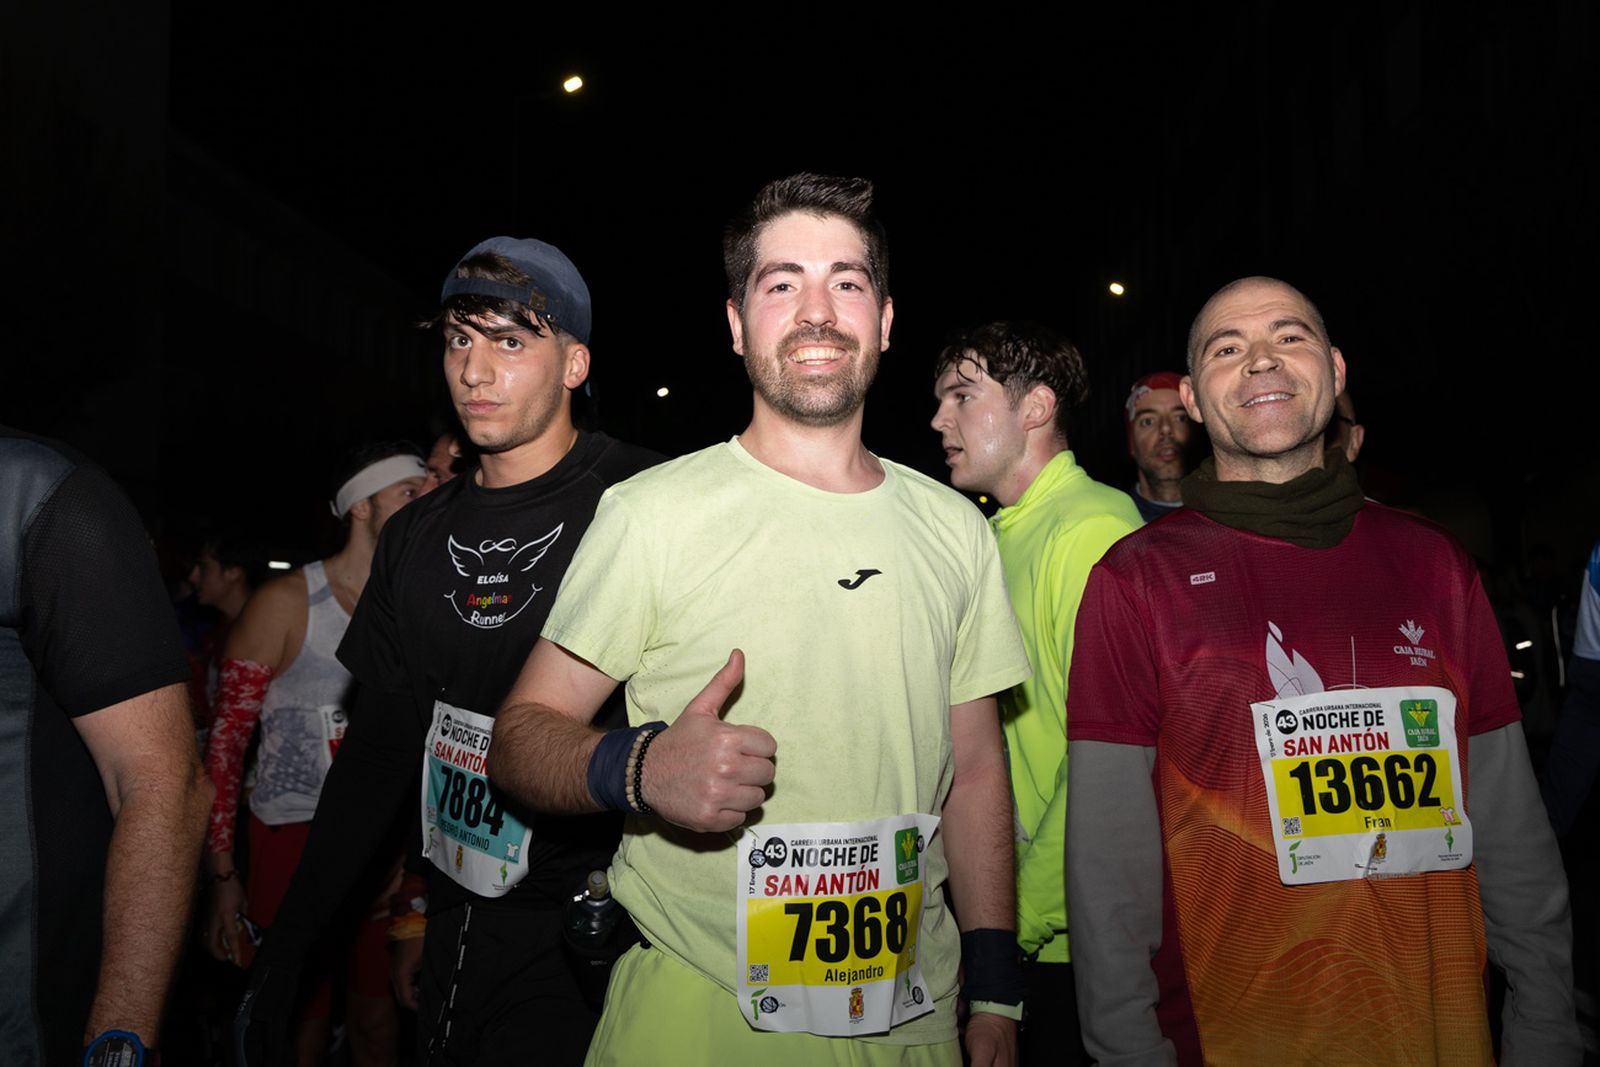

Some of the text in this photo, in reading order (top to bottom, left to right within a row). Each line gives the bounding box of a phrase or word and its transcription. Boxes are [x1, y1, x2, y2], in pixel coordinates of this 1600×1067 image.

[477, 572, 509, 584] ELOÍSA
[470, 610, 506, 625] Runner
[1277, 715, 1296, 729] 43
[1302, 710, 1385, 731] NOCHE DE
[449, 725, 478, 748] NOCHE
[479, 737, 490, 751] D
[1284, 727, 1390, 757] SAN ANTÓN
[434, 741, 454, 762] SAN
[1289, 753, 1441, 816] 13662
[439, 765, 504, 837] 7884
[1364, 816, 1391, 829] Fran
[458, 829, 490, 850] ANTONIO
[764, 844, 786, 859] 43
[791, 843, 878, 868] NOCHE DE
[749, 887, 755, 895] 17
[764, 873, 810, 896] SAN
[814, 865, 880, 896] ANTÓN
[784, 892, 908, 963] 7368
[825, 965, 884, 985] Alejandro
